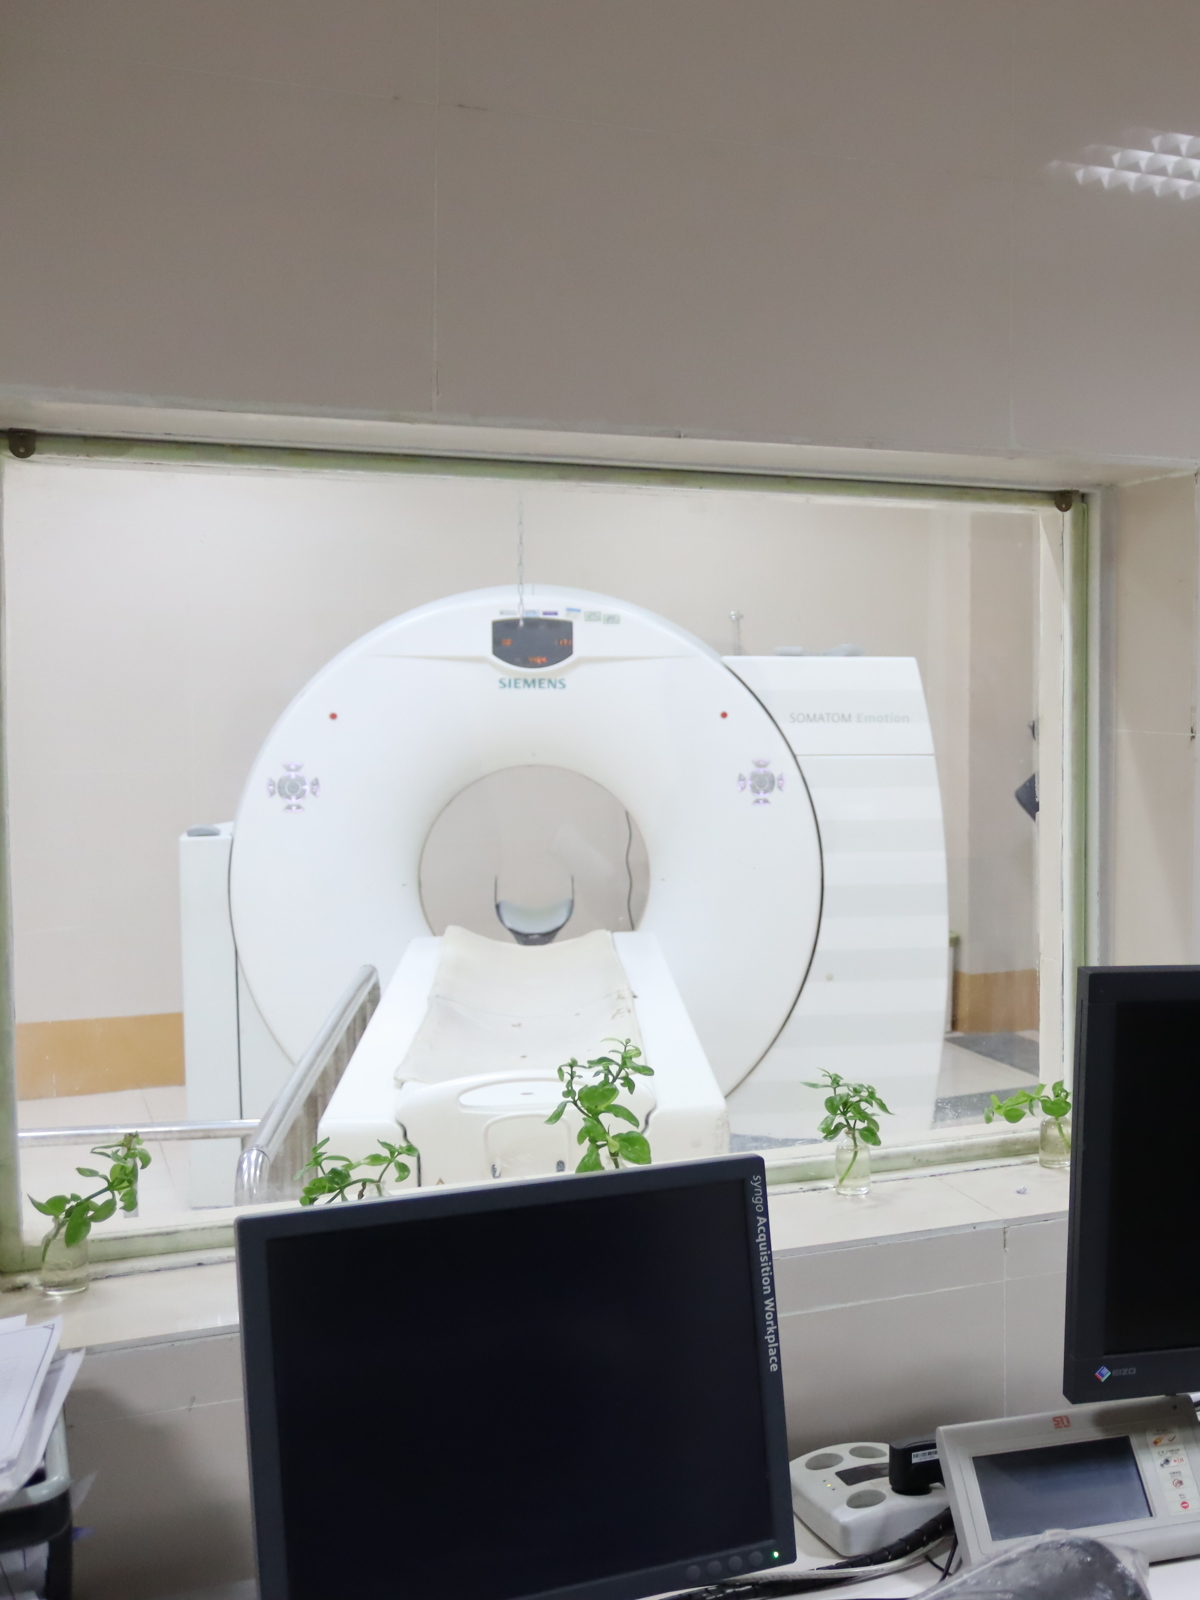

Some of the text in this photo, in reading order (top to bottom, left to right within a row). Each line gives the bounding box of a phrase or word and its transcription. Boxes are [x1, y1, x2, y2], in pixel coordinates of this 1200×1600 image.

[498, 678, 566, 689] SIEMENS
[788, 712, 910, 723] SOMATOM Emotion
[750, 1175, 778, 1372] syngo Acquisition Workplace
[1112, 1368, 1136, 1376] EIZO
